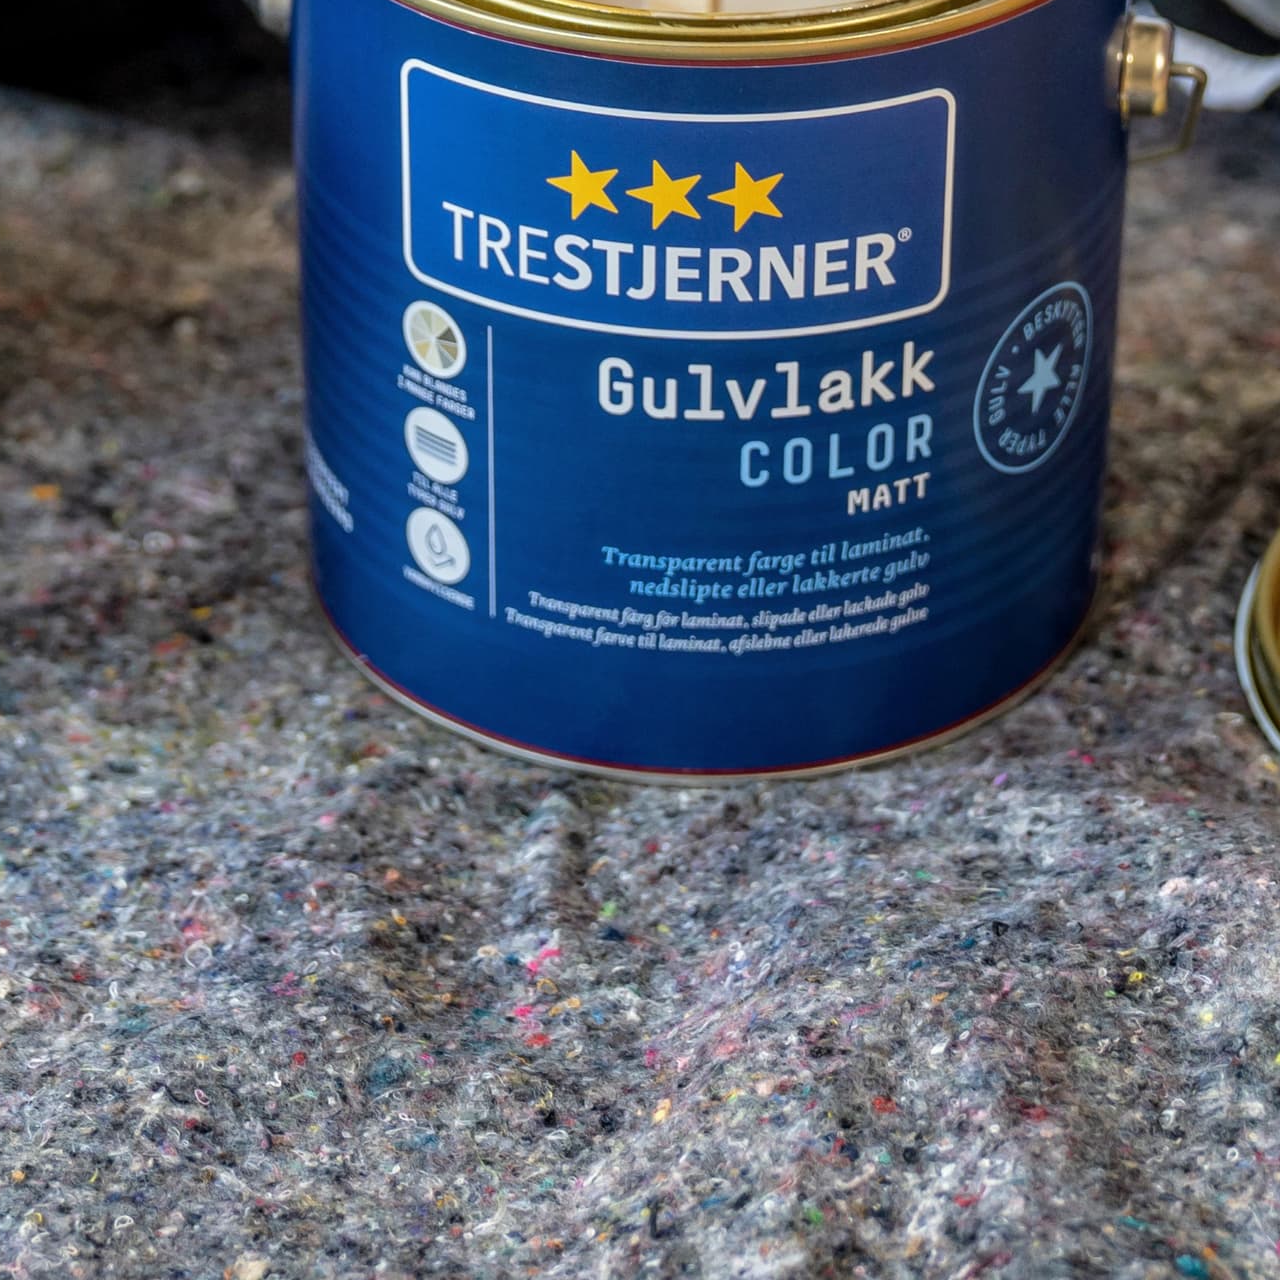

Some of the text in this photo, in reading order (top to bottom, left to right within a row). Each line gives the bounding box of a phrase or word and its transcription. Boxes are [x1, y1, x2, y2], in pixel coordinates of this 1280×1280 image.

[598, 341, 936, 420] Gulvlakk
[988, 365, 1011, 426] GULV
[739, 414, 933, 488] COLOR
[847, 472, 931, 516] MATT
[601, 545, 743, 575] Transparent
[743, 551, 806, 577] farge
[810, 543, 836, 565] til
[629, 549, 931, 605] nedslipte eller lakkerte gulv
[504, 606, 595, 639] Transparent
[793, 627, 830, 647] eller
[528, 590, 620, 621] Transparent
[751, 607, 808, 632] slipade
[807, 603, 843, 623] eller
[843, 589, 898, 618] lackade
